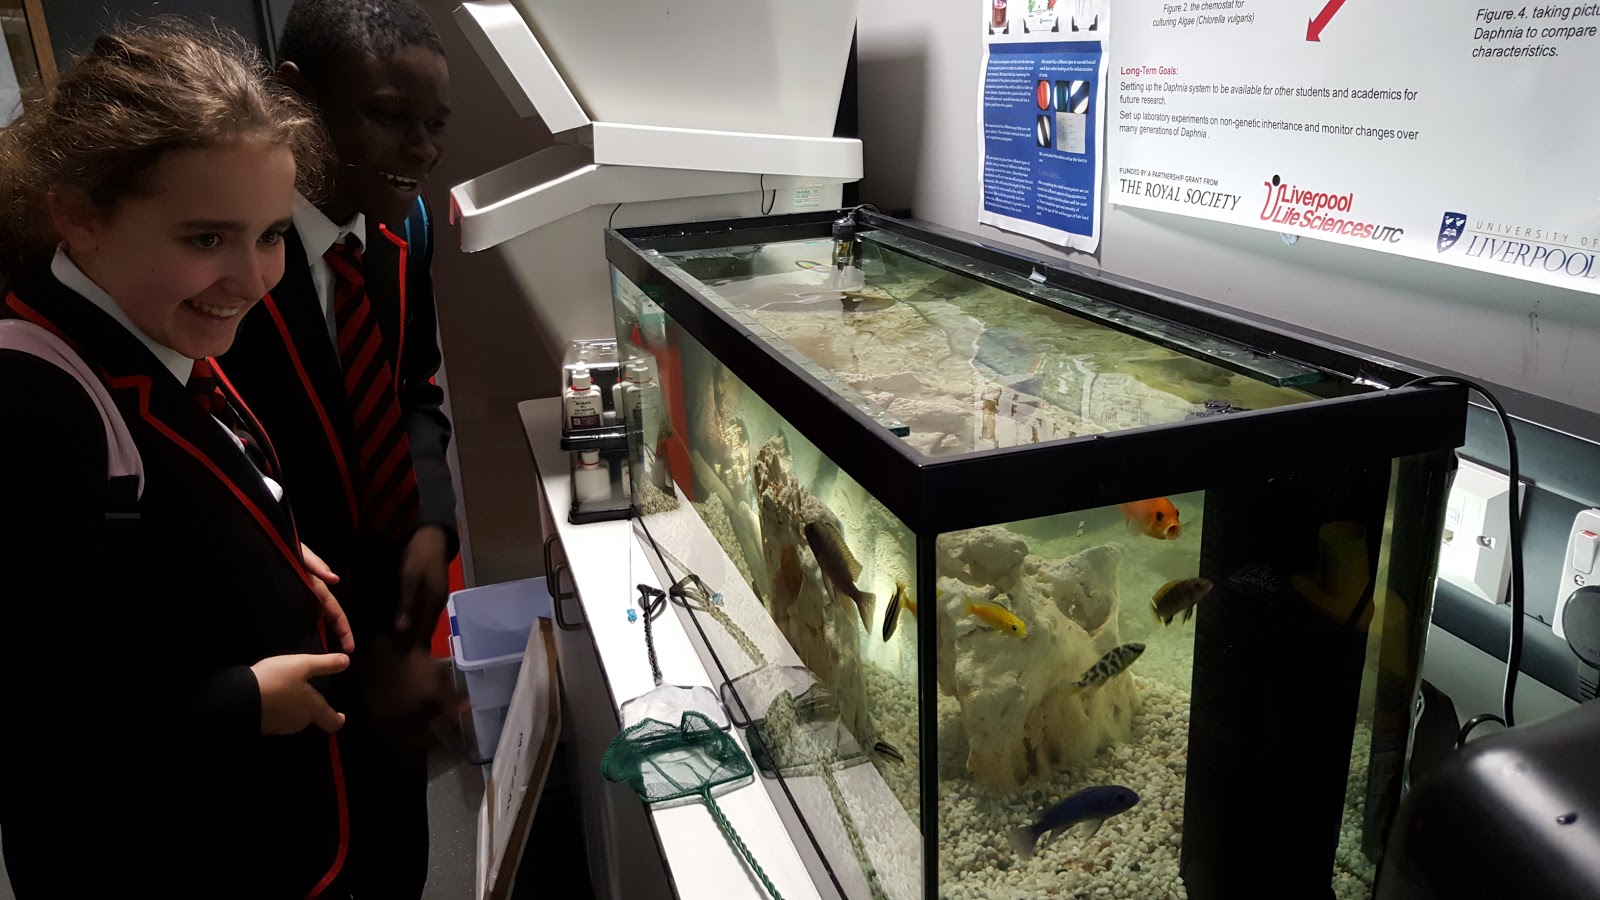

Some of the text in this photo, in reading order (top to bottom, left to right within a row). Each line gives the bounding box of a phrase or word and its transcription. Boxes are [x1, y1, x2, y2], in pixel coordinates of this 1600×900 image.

[1190, 2, 1200, 11] the
[1201, 1, 1234, 11] chemostat
[1234, 0, 1245, 9] for
[1532, 5, 1570, 20] taking
[1152, 18, 1177, 28] culturing
[1177, 17, 1195, 28] Algae
[1474, 26, 1597, 42] Daphnia to compare
[1472, 44, 1559, 58] characteristics.
[1120, 65, 1179, 77] Long-Term Goals:
[1120, 81, 1418, 101] Setting up the Daphnia system to be available for other students and academics for
[1120, 95, 1166, 105] future research.
[1119, 125, 1138, 135] many
[1139, 125, 1172, 136] generations
[1172, 127, 1180, 136] of
[1120, 111, 1419, 140] Set up laboratory experiments on non-genetic inheritance and monitor changes over
[1119, 167, 1140, 176] FUNDED
[1152, 171, 1184, 181] PARTNERSHIP
[1185, 175, 1203, 184] GRANT
[1203, 178, 1219, 186] FROM
[1120, 178, 1241, 211] THE ROYAL SOCIETY
[1281, 183, 1354, 213] Liverpool
[1272, 205, 1301, 225] Life
[1476, 220, 1599, 248] UNIVERSITY OF
[1465, 235, 1597, 279] LIVERPOOL
